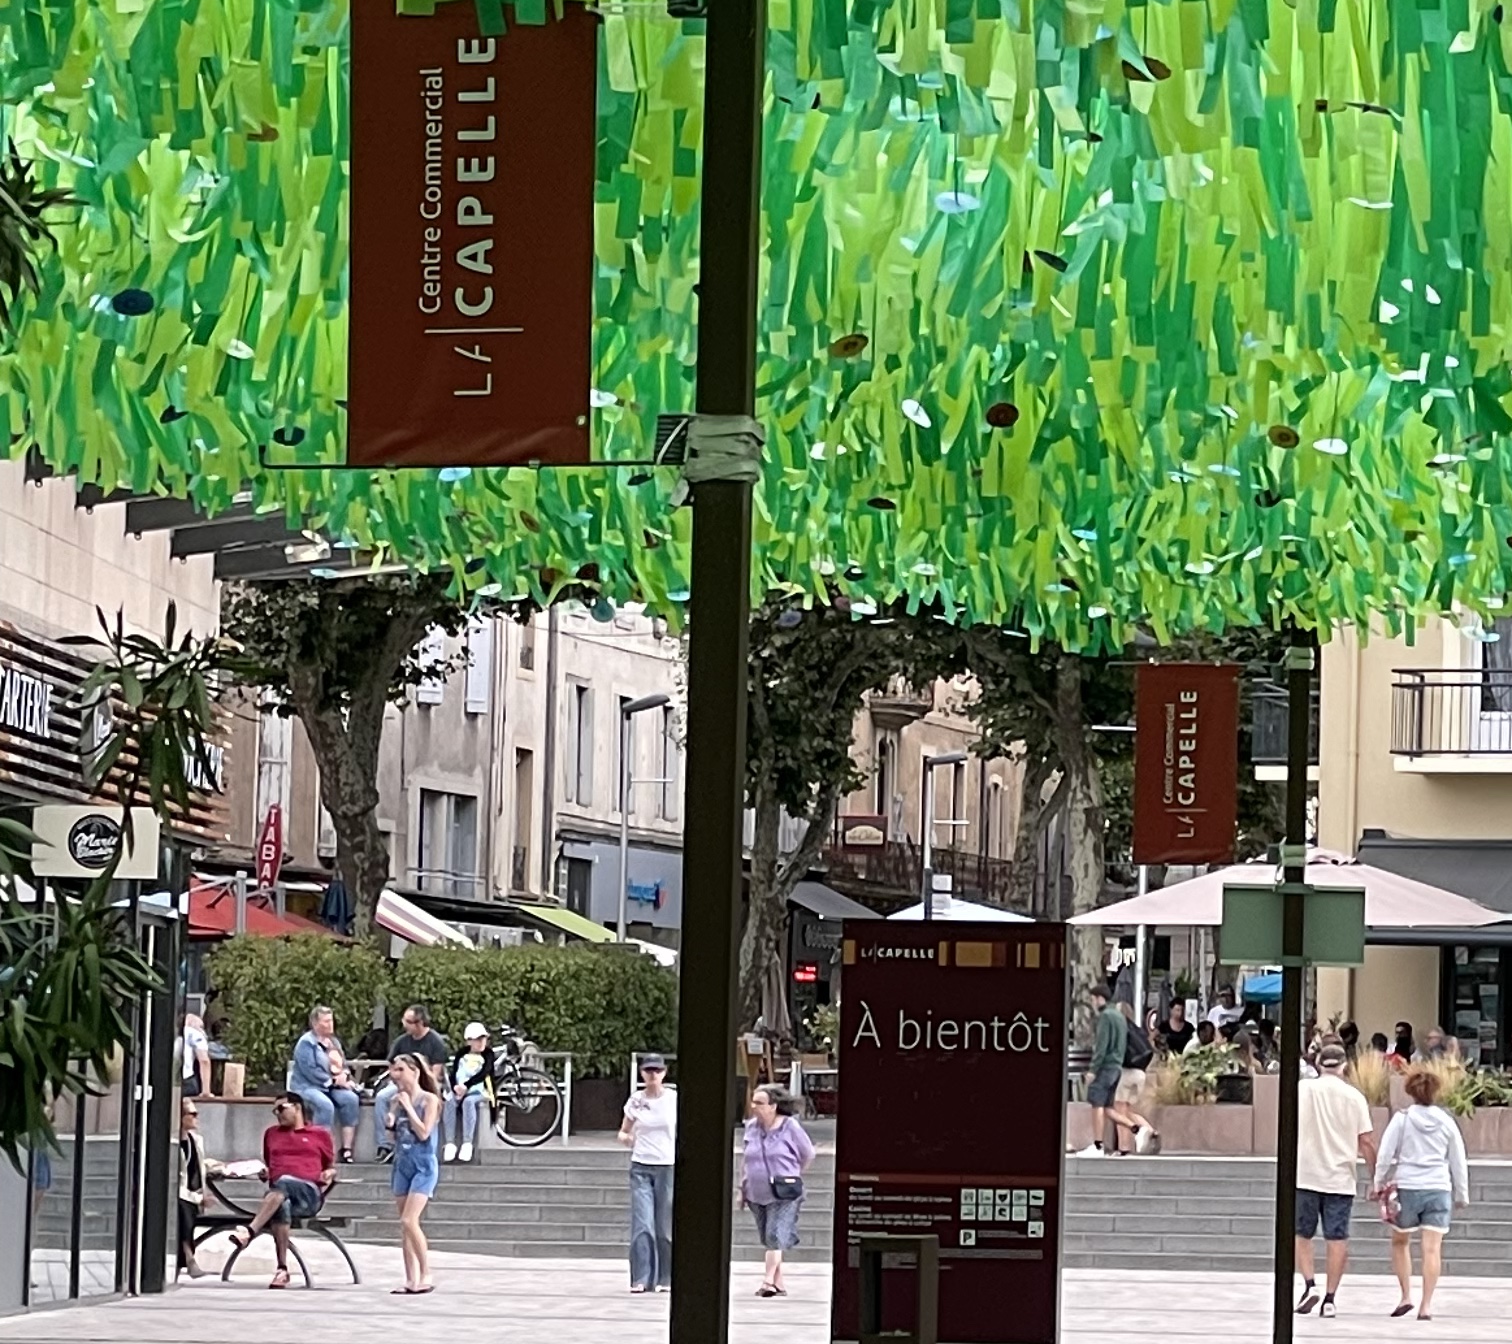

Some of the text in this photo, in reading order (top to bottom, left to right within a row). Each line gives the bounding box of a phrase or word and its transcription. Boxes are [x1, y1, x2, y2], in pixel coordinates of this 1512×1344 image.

[419, 67, 443, 314] Centre Commercial
[455, 38, 496, 317] CAPELLE
[1177, 691, 1198, 806] CAPELLE
[877, 947, 934, 959] CAPELLE
[853, 1000, 1050, 1052] À bientôt
